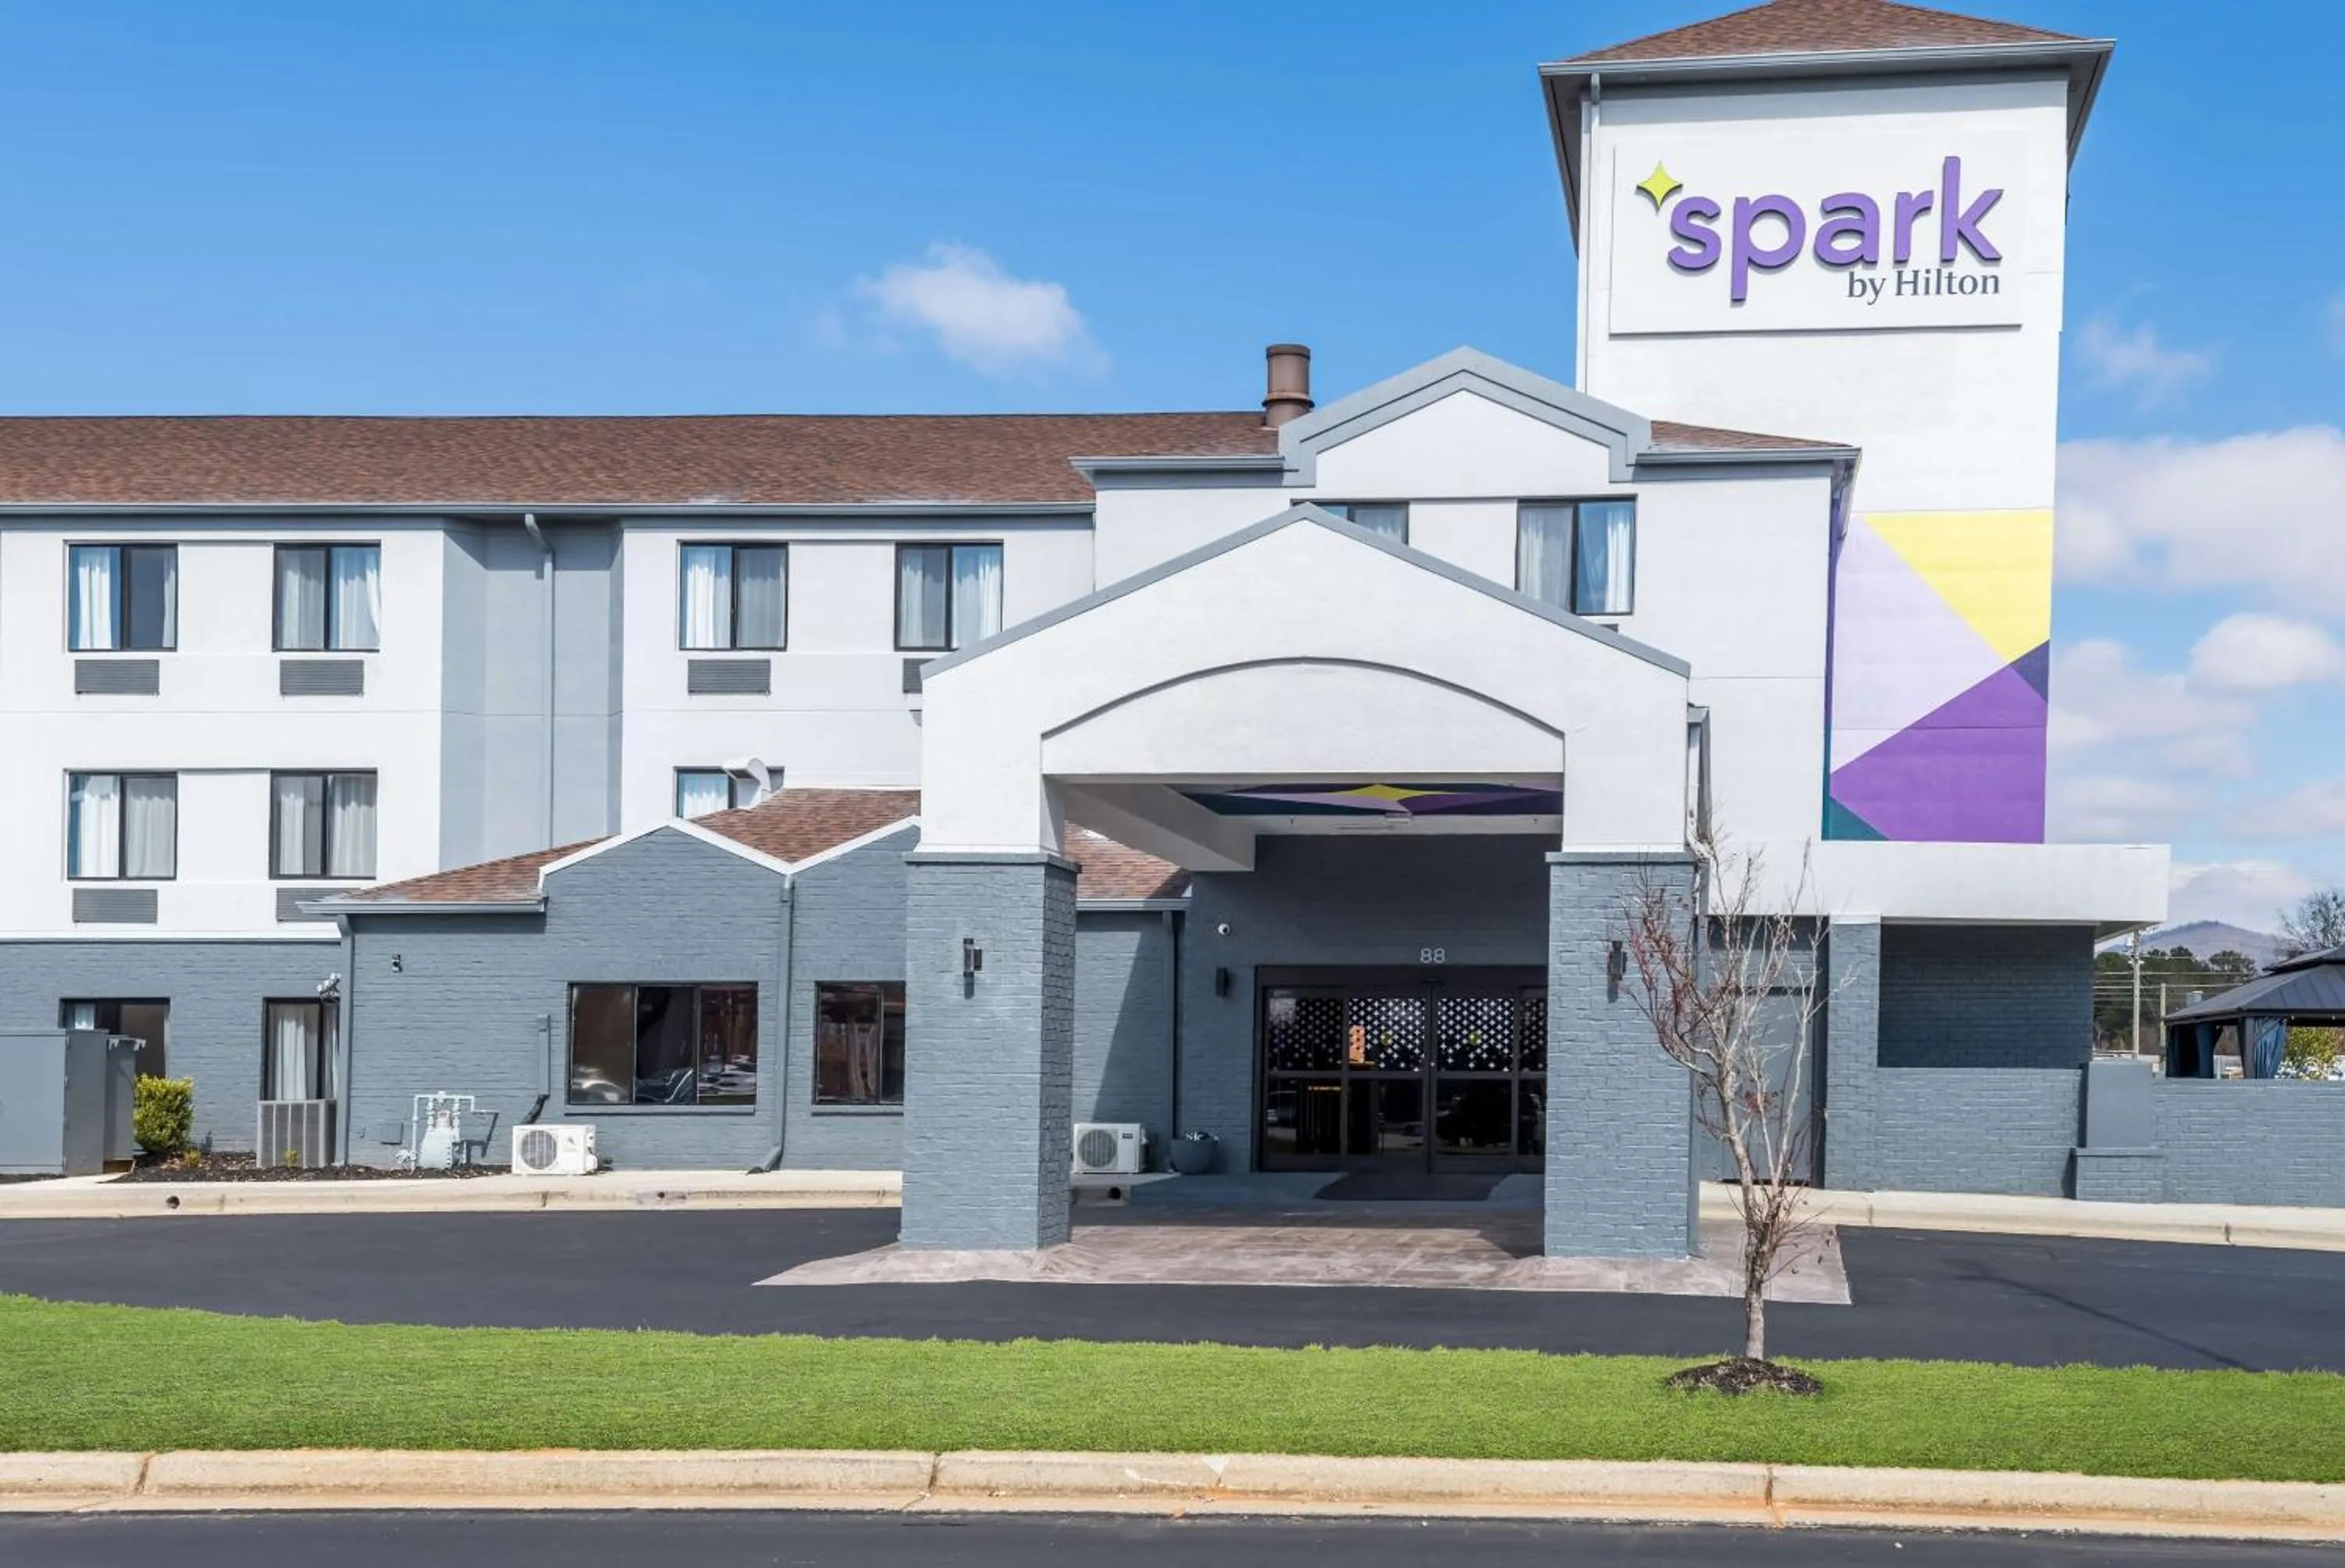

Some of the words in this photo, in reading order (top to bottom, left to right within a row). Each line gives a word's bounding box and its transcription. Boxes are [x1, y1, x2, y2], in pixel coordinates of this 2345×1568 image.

[1667, 156, 2004, 303] spark
[1848, 270, 1886, 306] by
[1895, 268, 2000, 296] Hilton
[1420, 947, 1445, 964] 88
